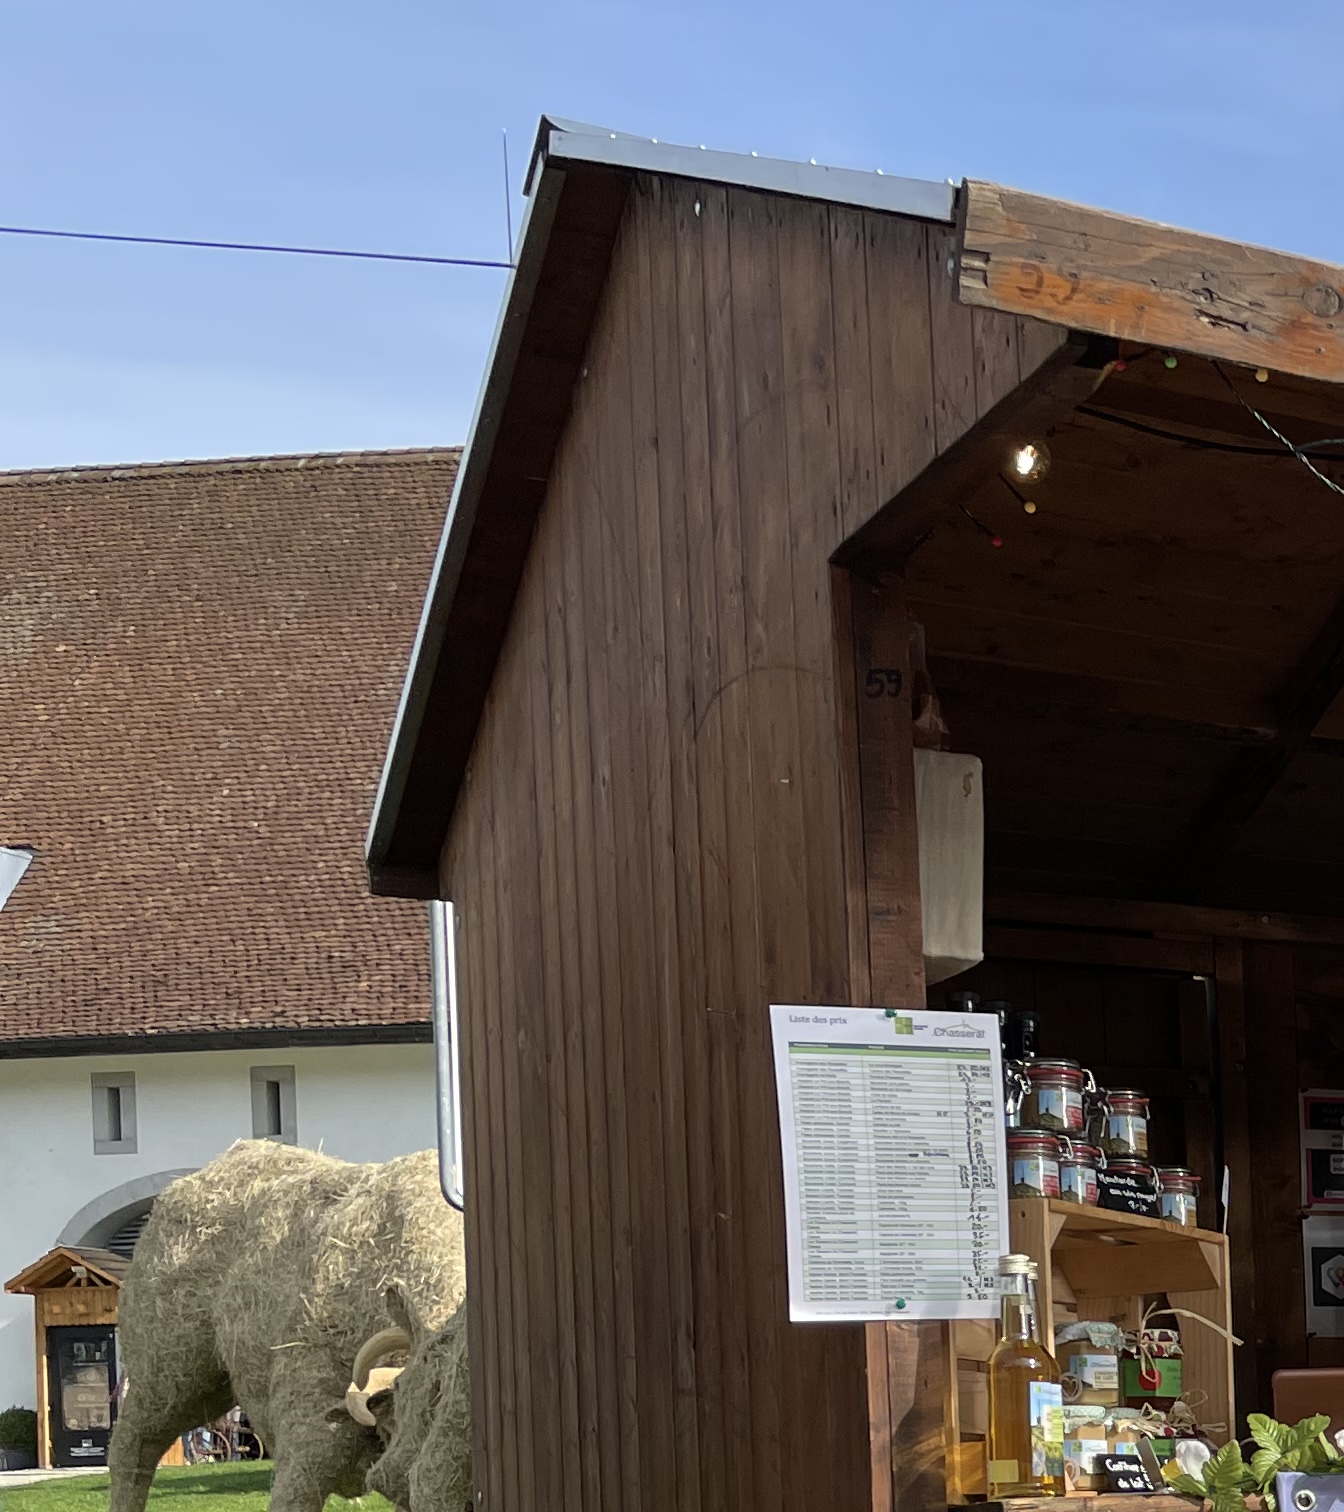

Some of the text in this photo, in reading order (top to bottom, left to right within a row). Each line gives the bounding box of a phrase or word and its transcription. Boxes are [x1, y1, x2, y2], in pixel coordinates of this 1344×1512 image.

[789, 1014, 848, 1026] Liste des prix
